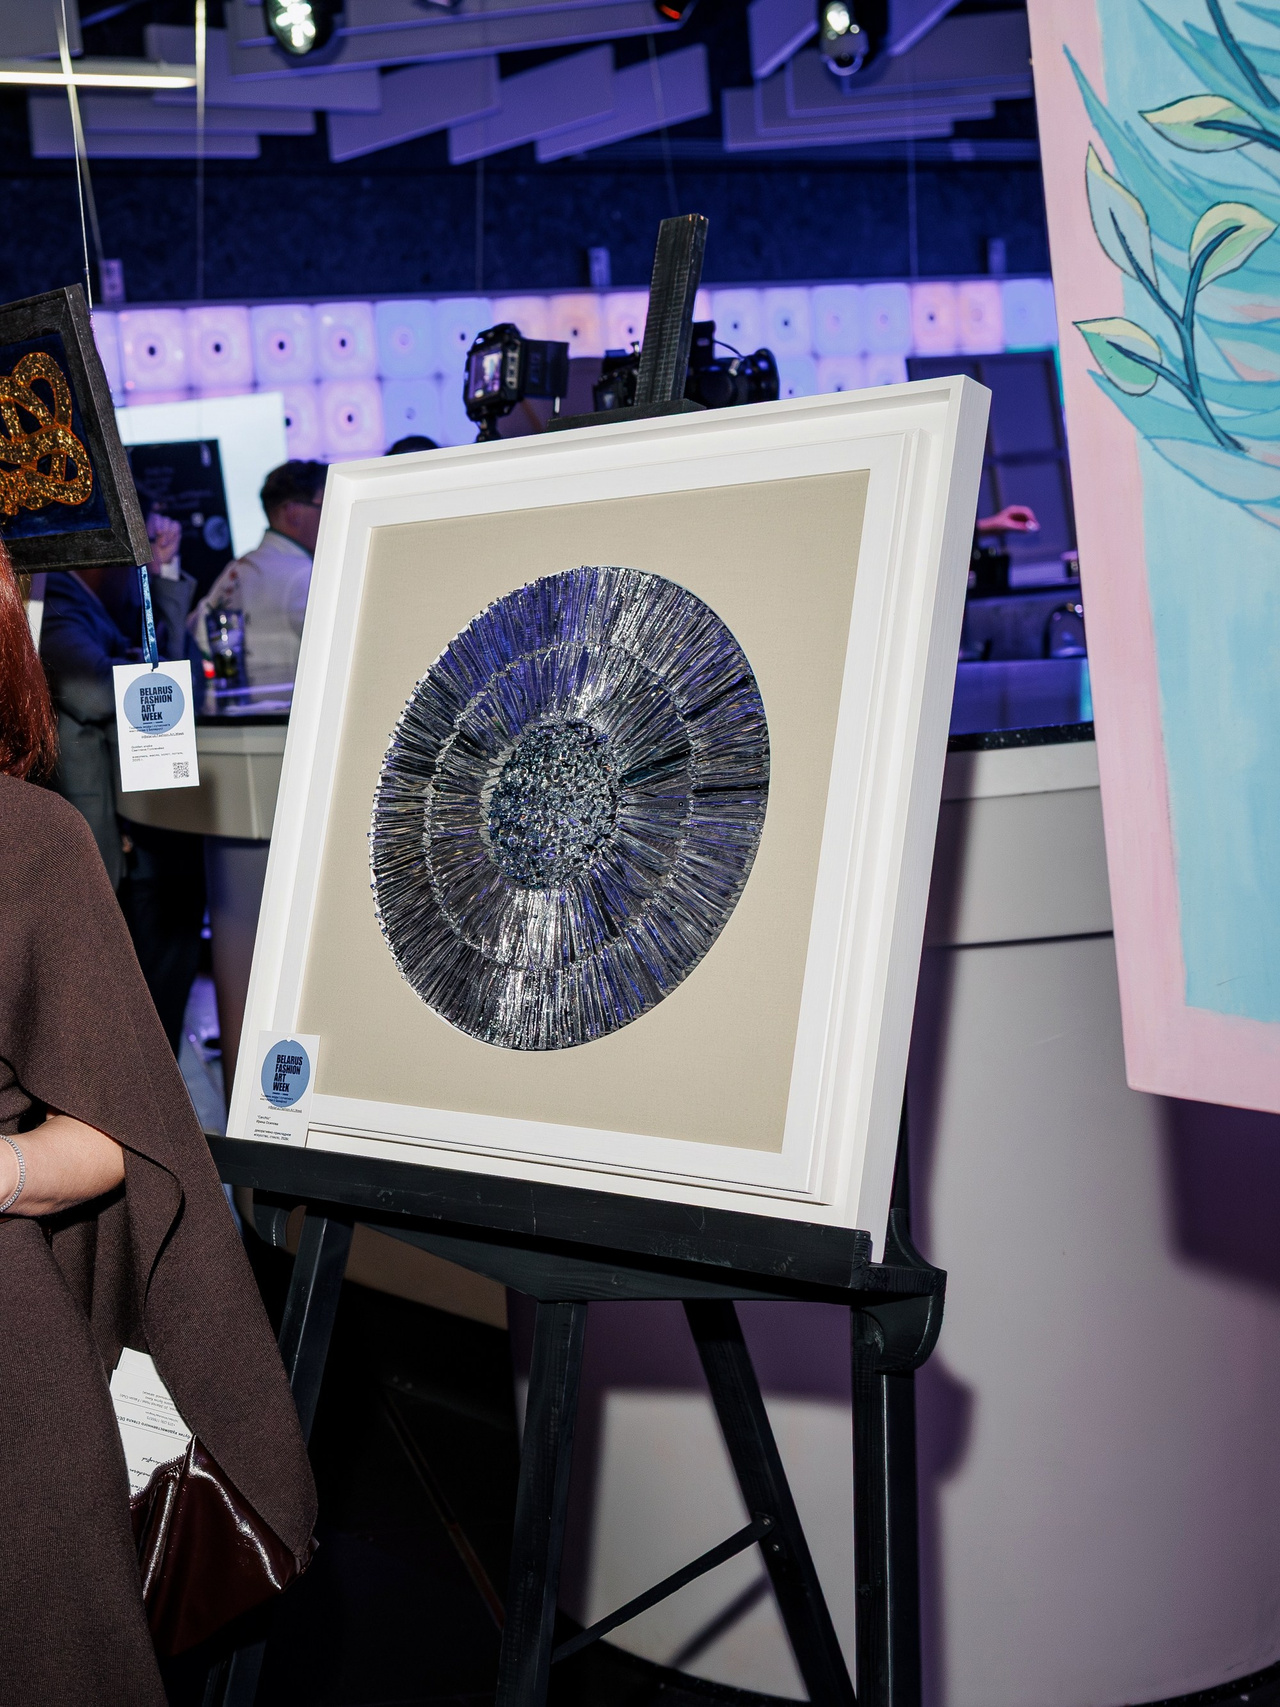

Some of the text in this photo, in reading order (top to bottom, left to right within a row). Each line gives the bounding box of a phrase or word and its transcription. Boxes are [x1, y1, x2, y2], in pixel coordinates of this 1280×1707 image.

[140, 686, 172, 696] BELARUS
[141, 695, 172, 704] FASHION
[142, 704, 155, 712] ART
[142, 712, 163, 721] WEEK
[277, 1055, 303, 1065] BELARUS
[275, 1064, 301, 1075] FASHION
[274, 1073, 286, 1082] ART
[273, 1082, 290, 1092] WEEK
